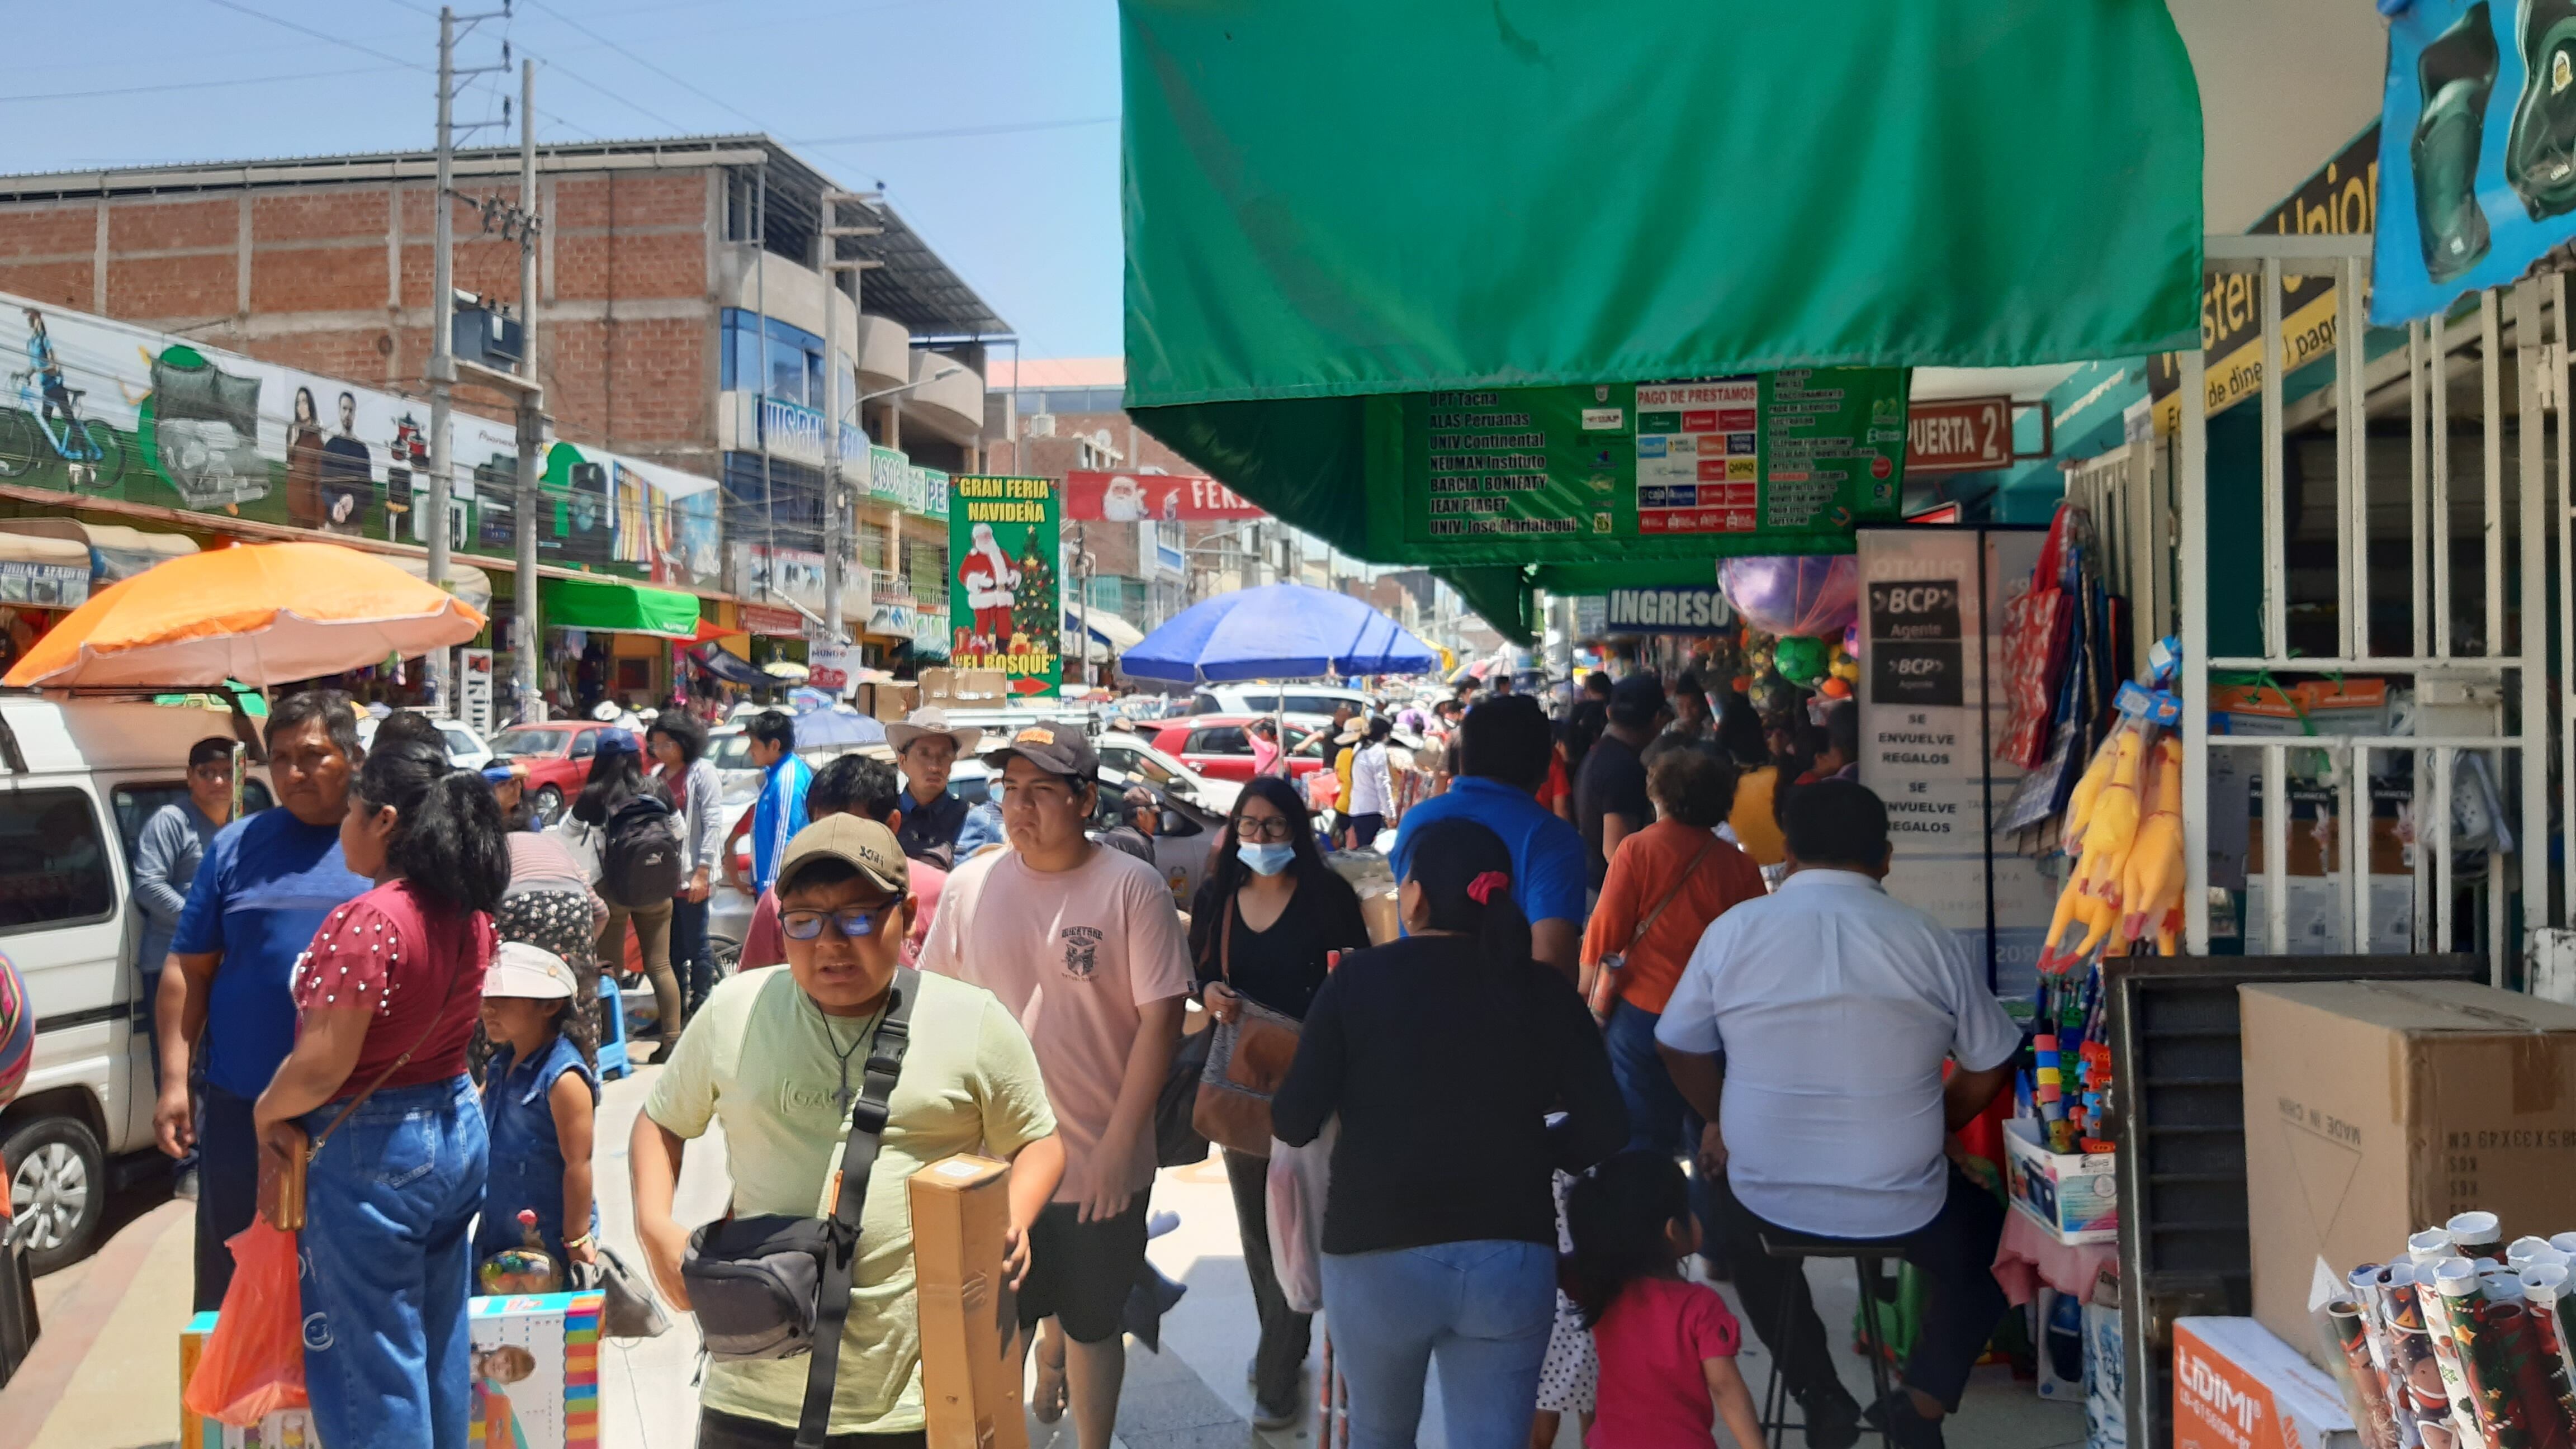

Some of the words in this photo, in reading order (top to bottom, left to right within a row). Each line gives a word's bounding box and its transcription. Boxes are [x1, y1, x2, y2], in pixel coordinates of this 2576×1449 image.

[1457, 391, 1498, 406] Tacna
[1638, 387, 1667, 404] PAGO
[1670, 387, 1686, 402] DE
[1688, 386, 1756, 402] PRESTAMOS
[2209, 381, 2225, 408] de
[1429, 415, 1461, 430] ALAS
[1464, 413, 1530, 429] Peruanas
[1429, 435, 1461, 451] UNIV
[1464, 432, 1545, 449] Continental
[1982, 405, 1999, 460] 2
[1429, 456, 1483, 472] NEUMAN
[1488, 453, 1547, 470] Instituto
[960, 477, 1003, 498] GRAN
[1006, 479, 1049, 499] FERIA
[968, 500, 1046, 523] NAVIDEÑA
[1429, 499, 1459, 514] JEAN
[1462, 496, 1508, 513] PIAGET
[1609, 589, 1730, 628] INGRESO
[1888, 587, 1940, 614] BCP
[1890, 623, 1942, 640] Agente
[1897, 657, 1935, 675] BCP
[1908, 714, 1926, 725] SE
[1878, 732, 1955, 745] ENVUELVE
[1882, 752, 1949, 765] REGALOS
[1909, 782, 1927, 793] SE
[2327, 1116, 2361, 1145] MADE
[2449, 1131, 2470, 1149] CM
